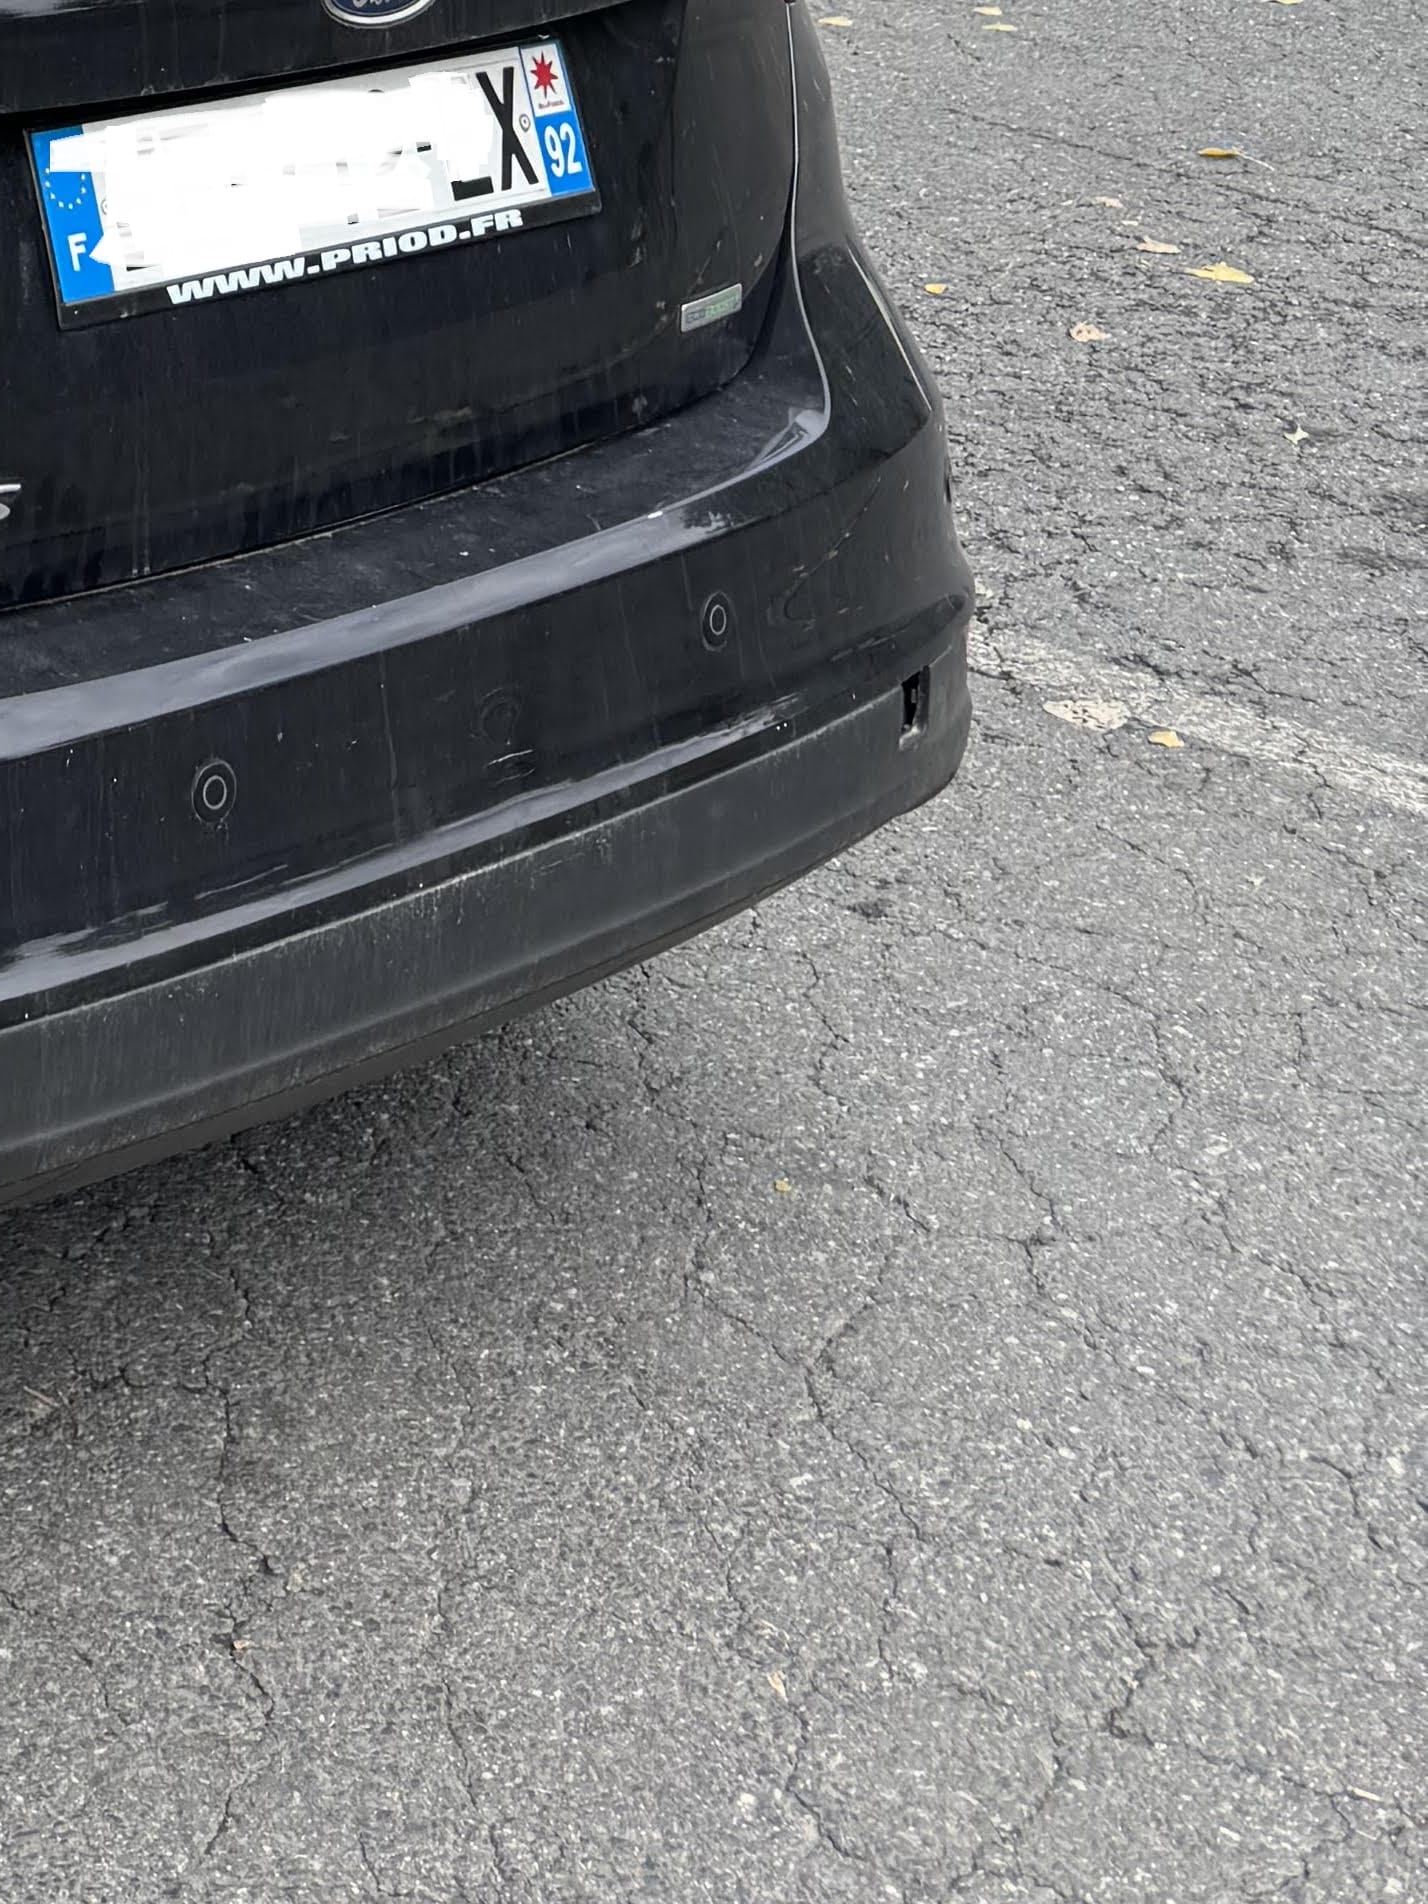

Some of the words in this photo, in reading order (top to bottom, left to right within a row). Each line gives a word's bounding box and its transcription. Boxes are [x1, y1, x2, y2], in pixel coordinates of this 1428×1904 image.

[544, 122, 583, 177] 92
[67, 232, 87, 271] F
[166, 208, 524, 305] WWW.PRIOD.FR
